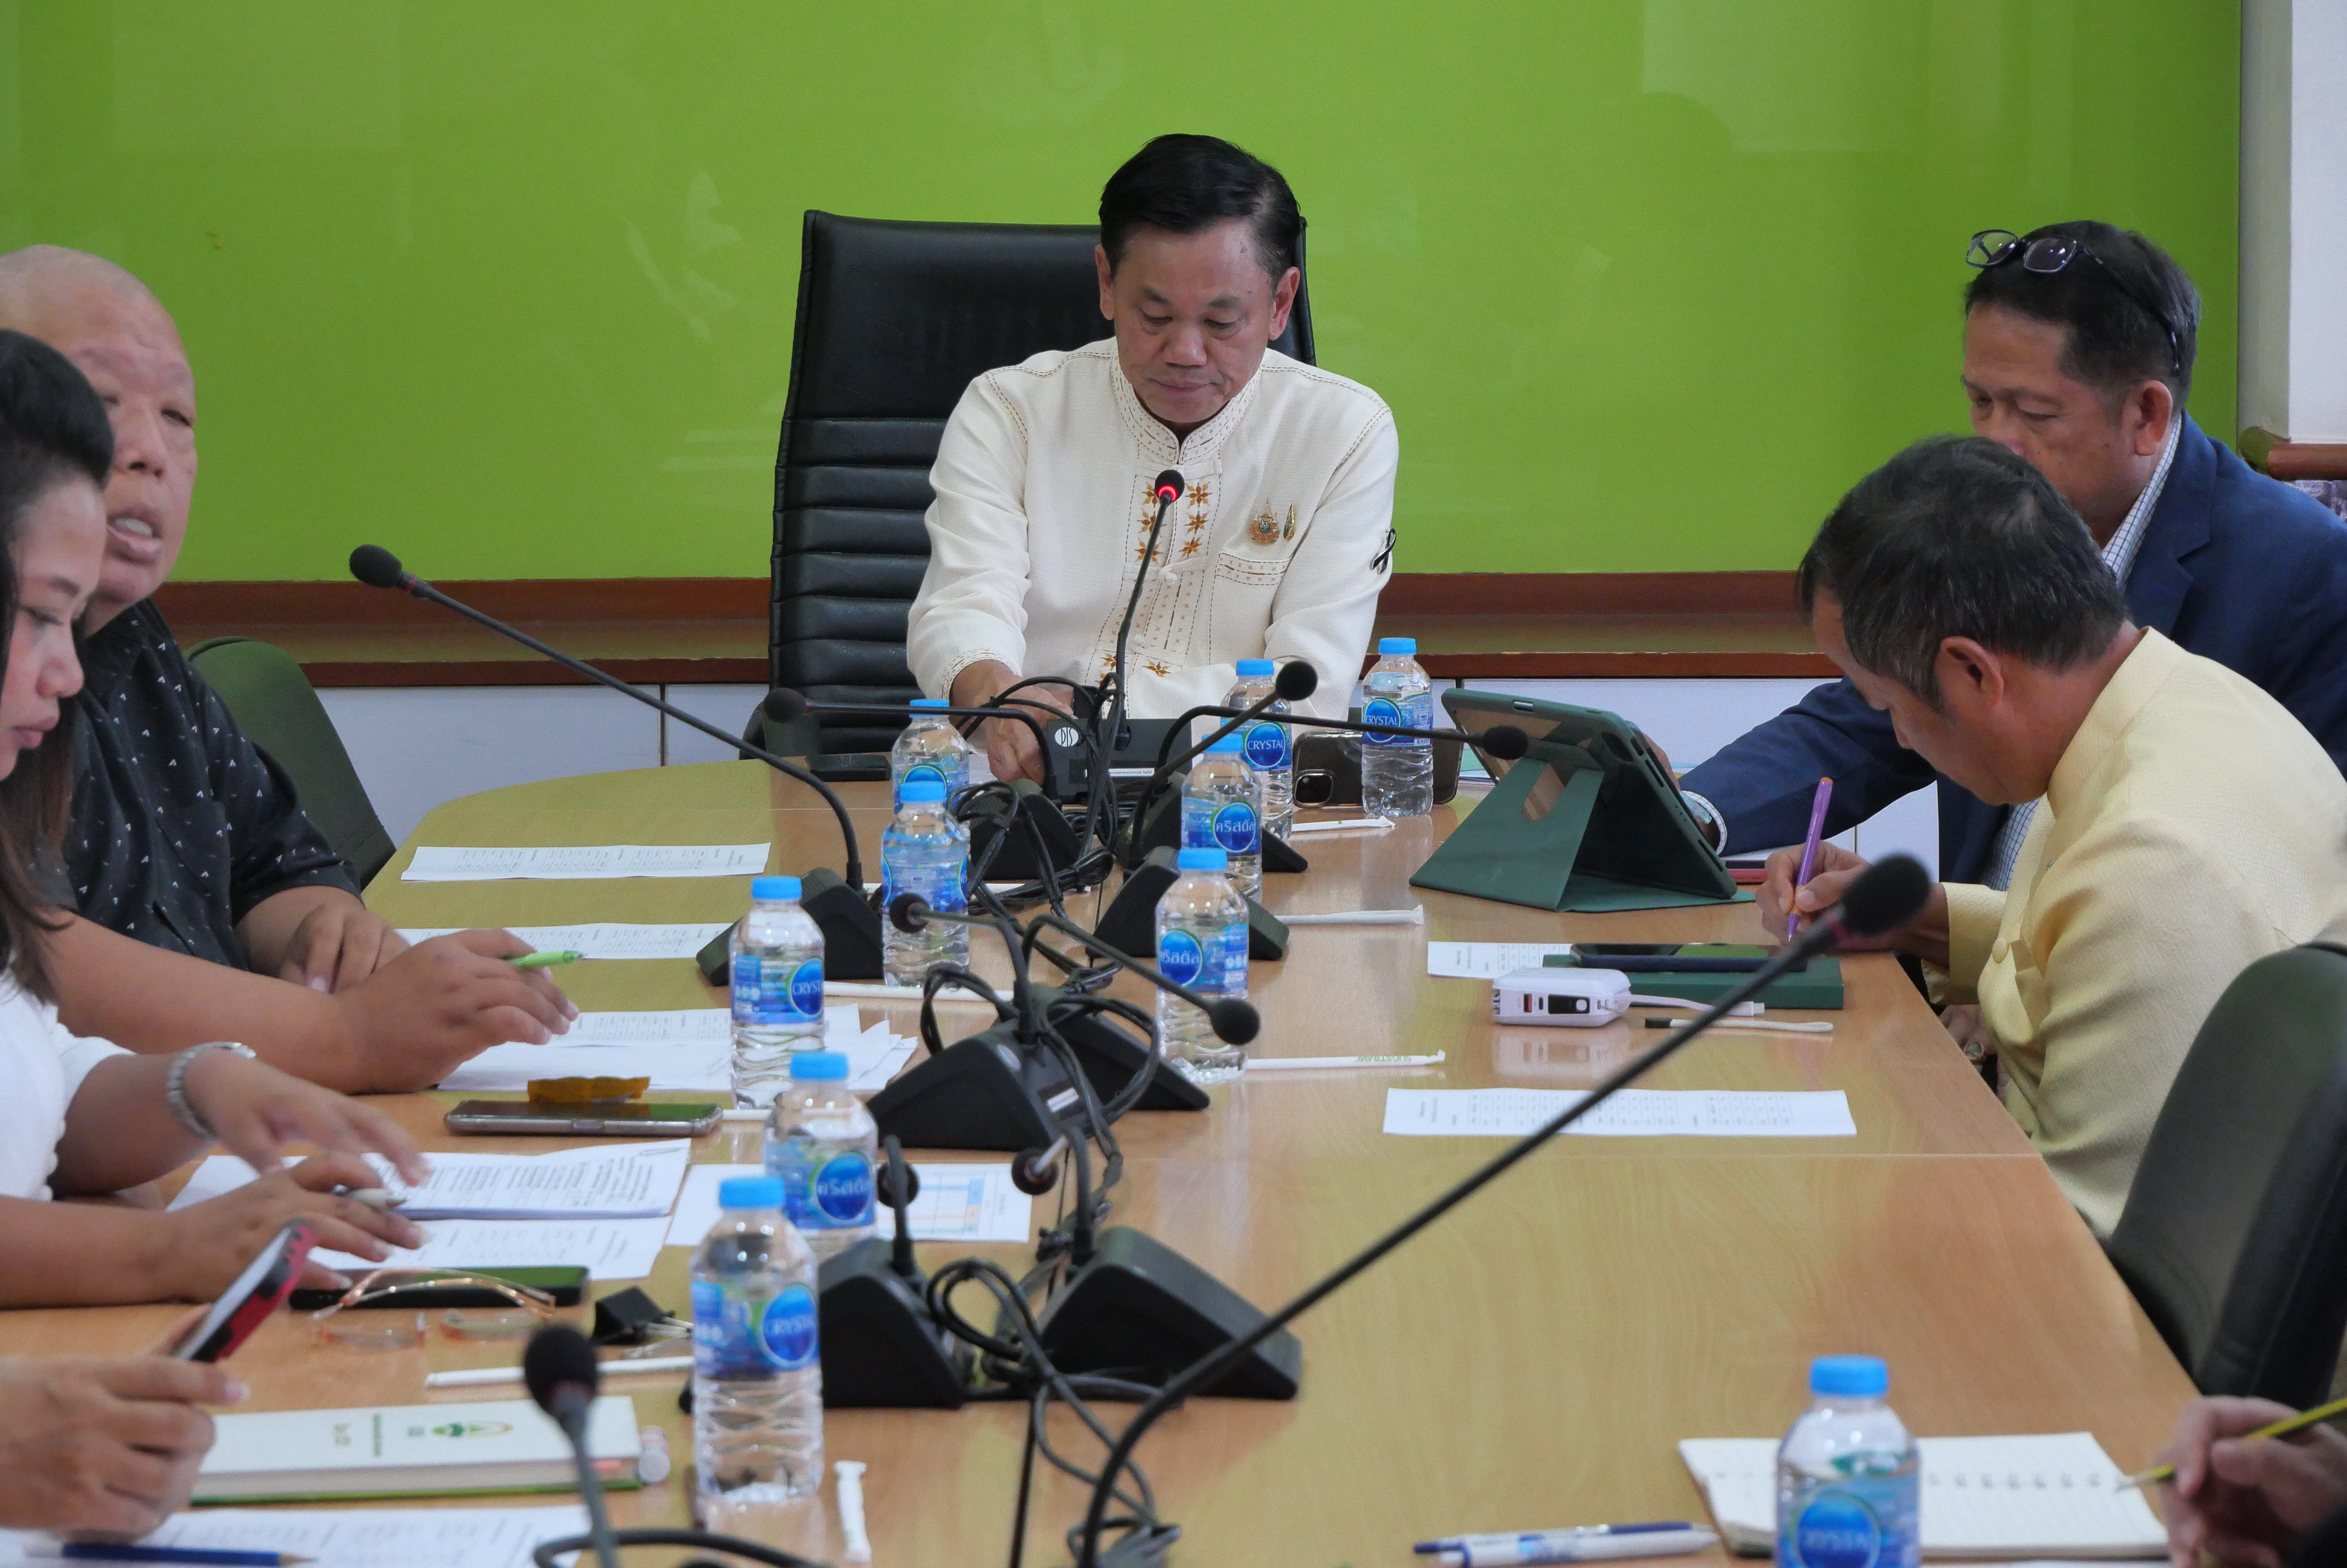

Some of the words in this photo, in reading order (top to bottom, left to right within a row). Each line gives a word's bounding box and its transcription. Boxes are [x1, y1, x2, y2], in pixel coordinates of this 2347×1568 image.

[1366, 715, 1399, 725] CRYSTAL
[1247, 739, 1284, 750] CRYSTAL
[792, 979, 823, 995] CRYST
